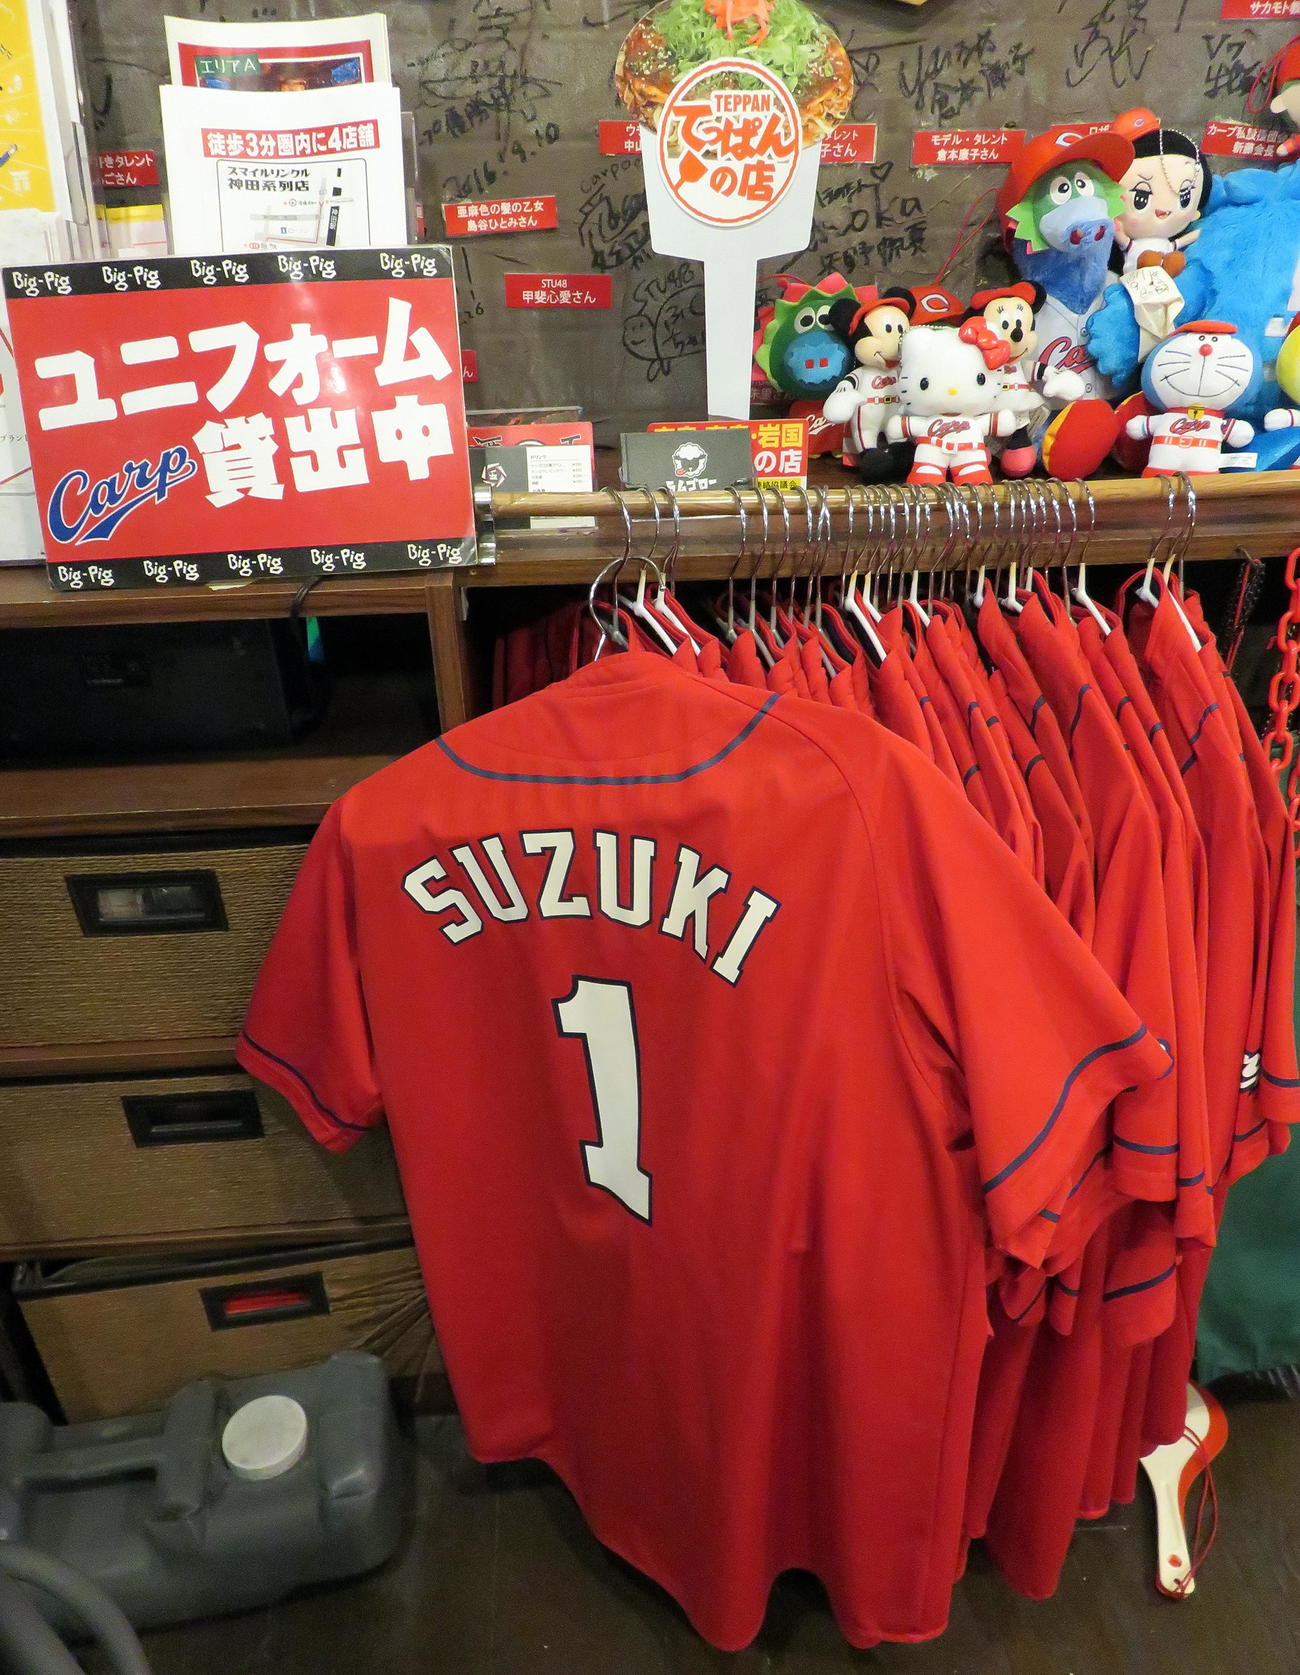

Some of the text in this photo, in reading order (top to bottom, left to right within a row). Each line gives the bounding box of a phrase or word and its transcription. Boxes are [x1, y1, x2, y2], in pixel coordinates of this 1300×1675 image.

[714, 94, 771, 112] TEPPAN
[207, 122, 376, 158] 徒歩3分圏内に4店舗
[672, 104, 797, 161] てっぱん
[227, 178, 310, 192] 神田系列店
[709, 159, 776, 201] の店
[12, 252, 438, 297] Big-Pig Big-Pig Big-Pig Big-Pig Big-Pig
[522, 289, 597, 304] 甲斐心愛さん
[541, 278, 568, 288] STU48
[34, 297, 453, 431] ユニフォーム
[192, 395, 454, 508] 貸出中
[754, 449, 803, 474] の店
[47, 445, 198, 545] Carp
[57, 543, 463, 589] Big-Pig Big-Pig Big-Pig Big-Pig Big-Pig
[402, 828, 781, 987] SUZUKI
[551, 974, 653, 1226] 1
